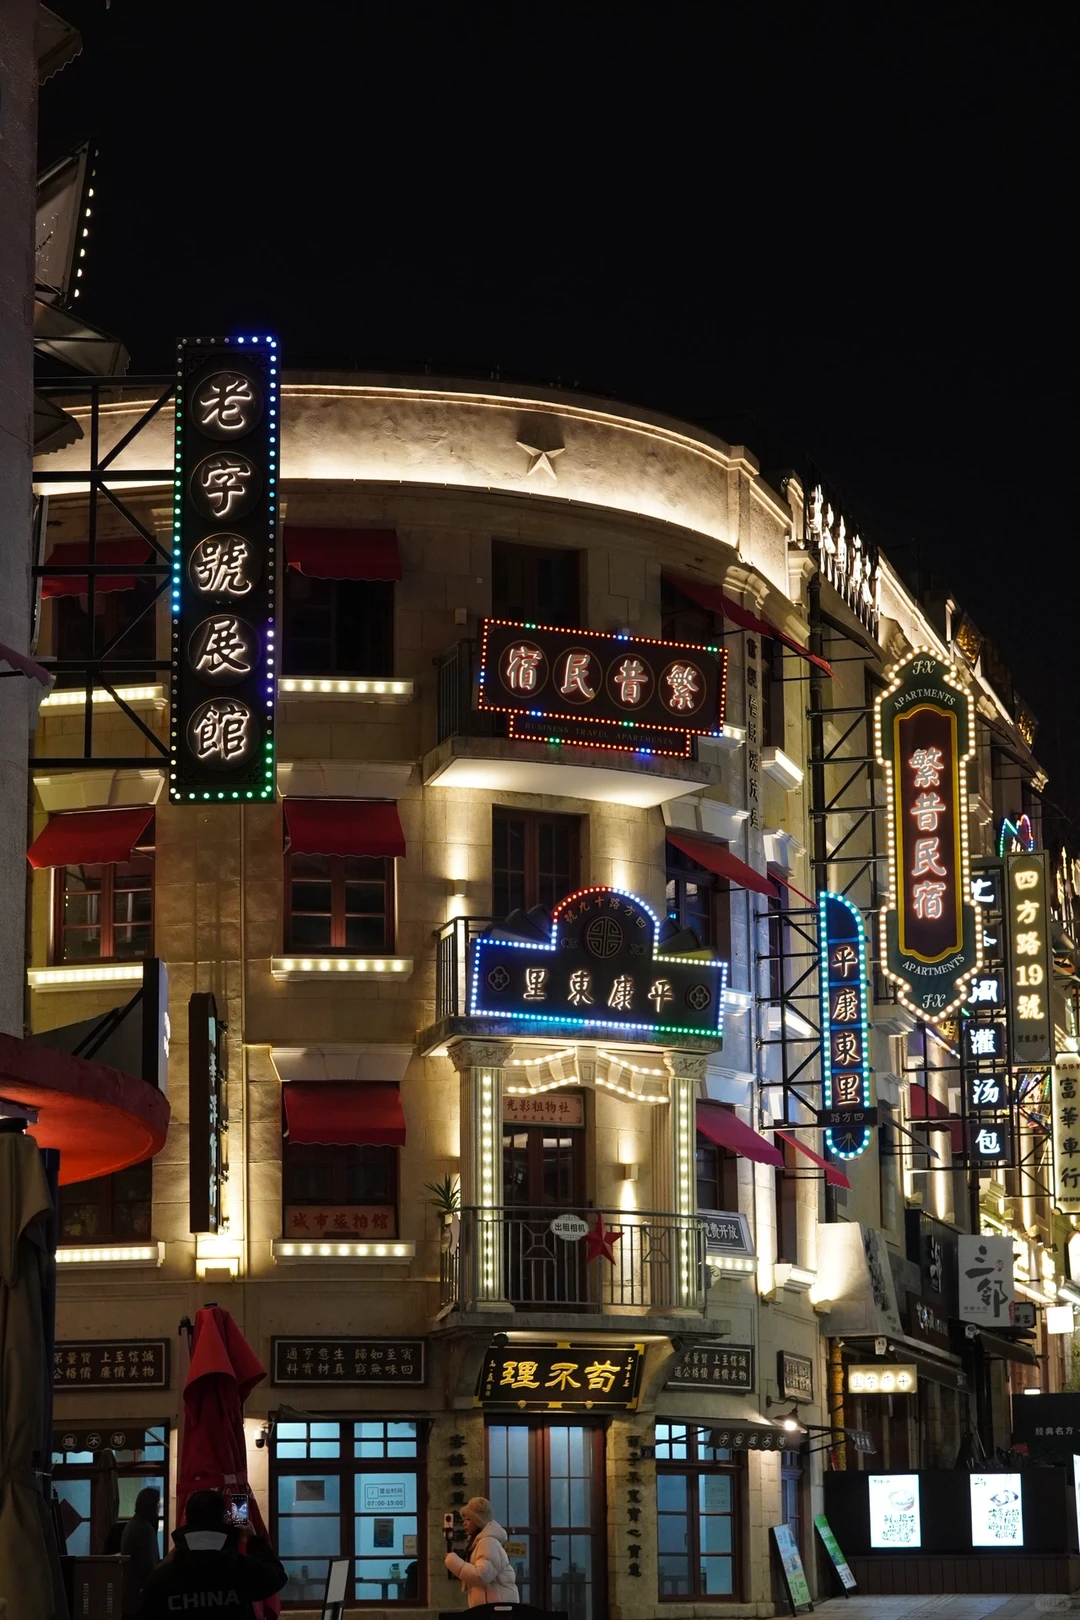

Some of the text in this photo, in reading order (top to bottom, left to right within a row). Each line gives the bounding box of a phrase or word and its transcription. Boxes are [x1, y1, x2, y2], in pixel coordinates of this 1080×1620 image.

[195, 374, 253, 760] 老字號展館
[893, 688, 957, 711] APARTMENTS
[525, 722, 674, 746] BUSINESS TRAVEL APARTMENTS
[909, 748, 946, 919] 繁昔民宿
[1014, 870, 1044, 1020] 四方路19號
[902, 954, 965, 976] APARTMENTS
[831, 945, 863, 1106] 平康東里
[507, 1099, 570, 1113] 光影租物社
[554, 1223, 586, 1233] 出租相机
[167, 1588, 241, 1611] CHINA
